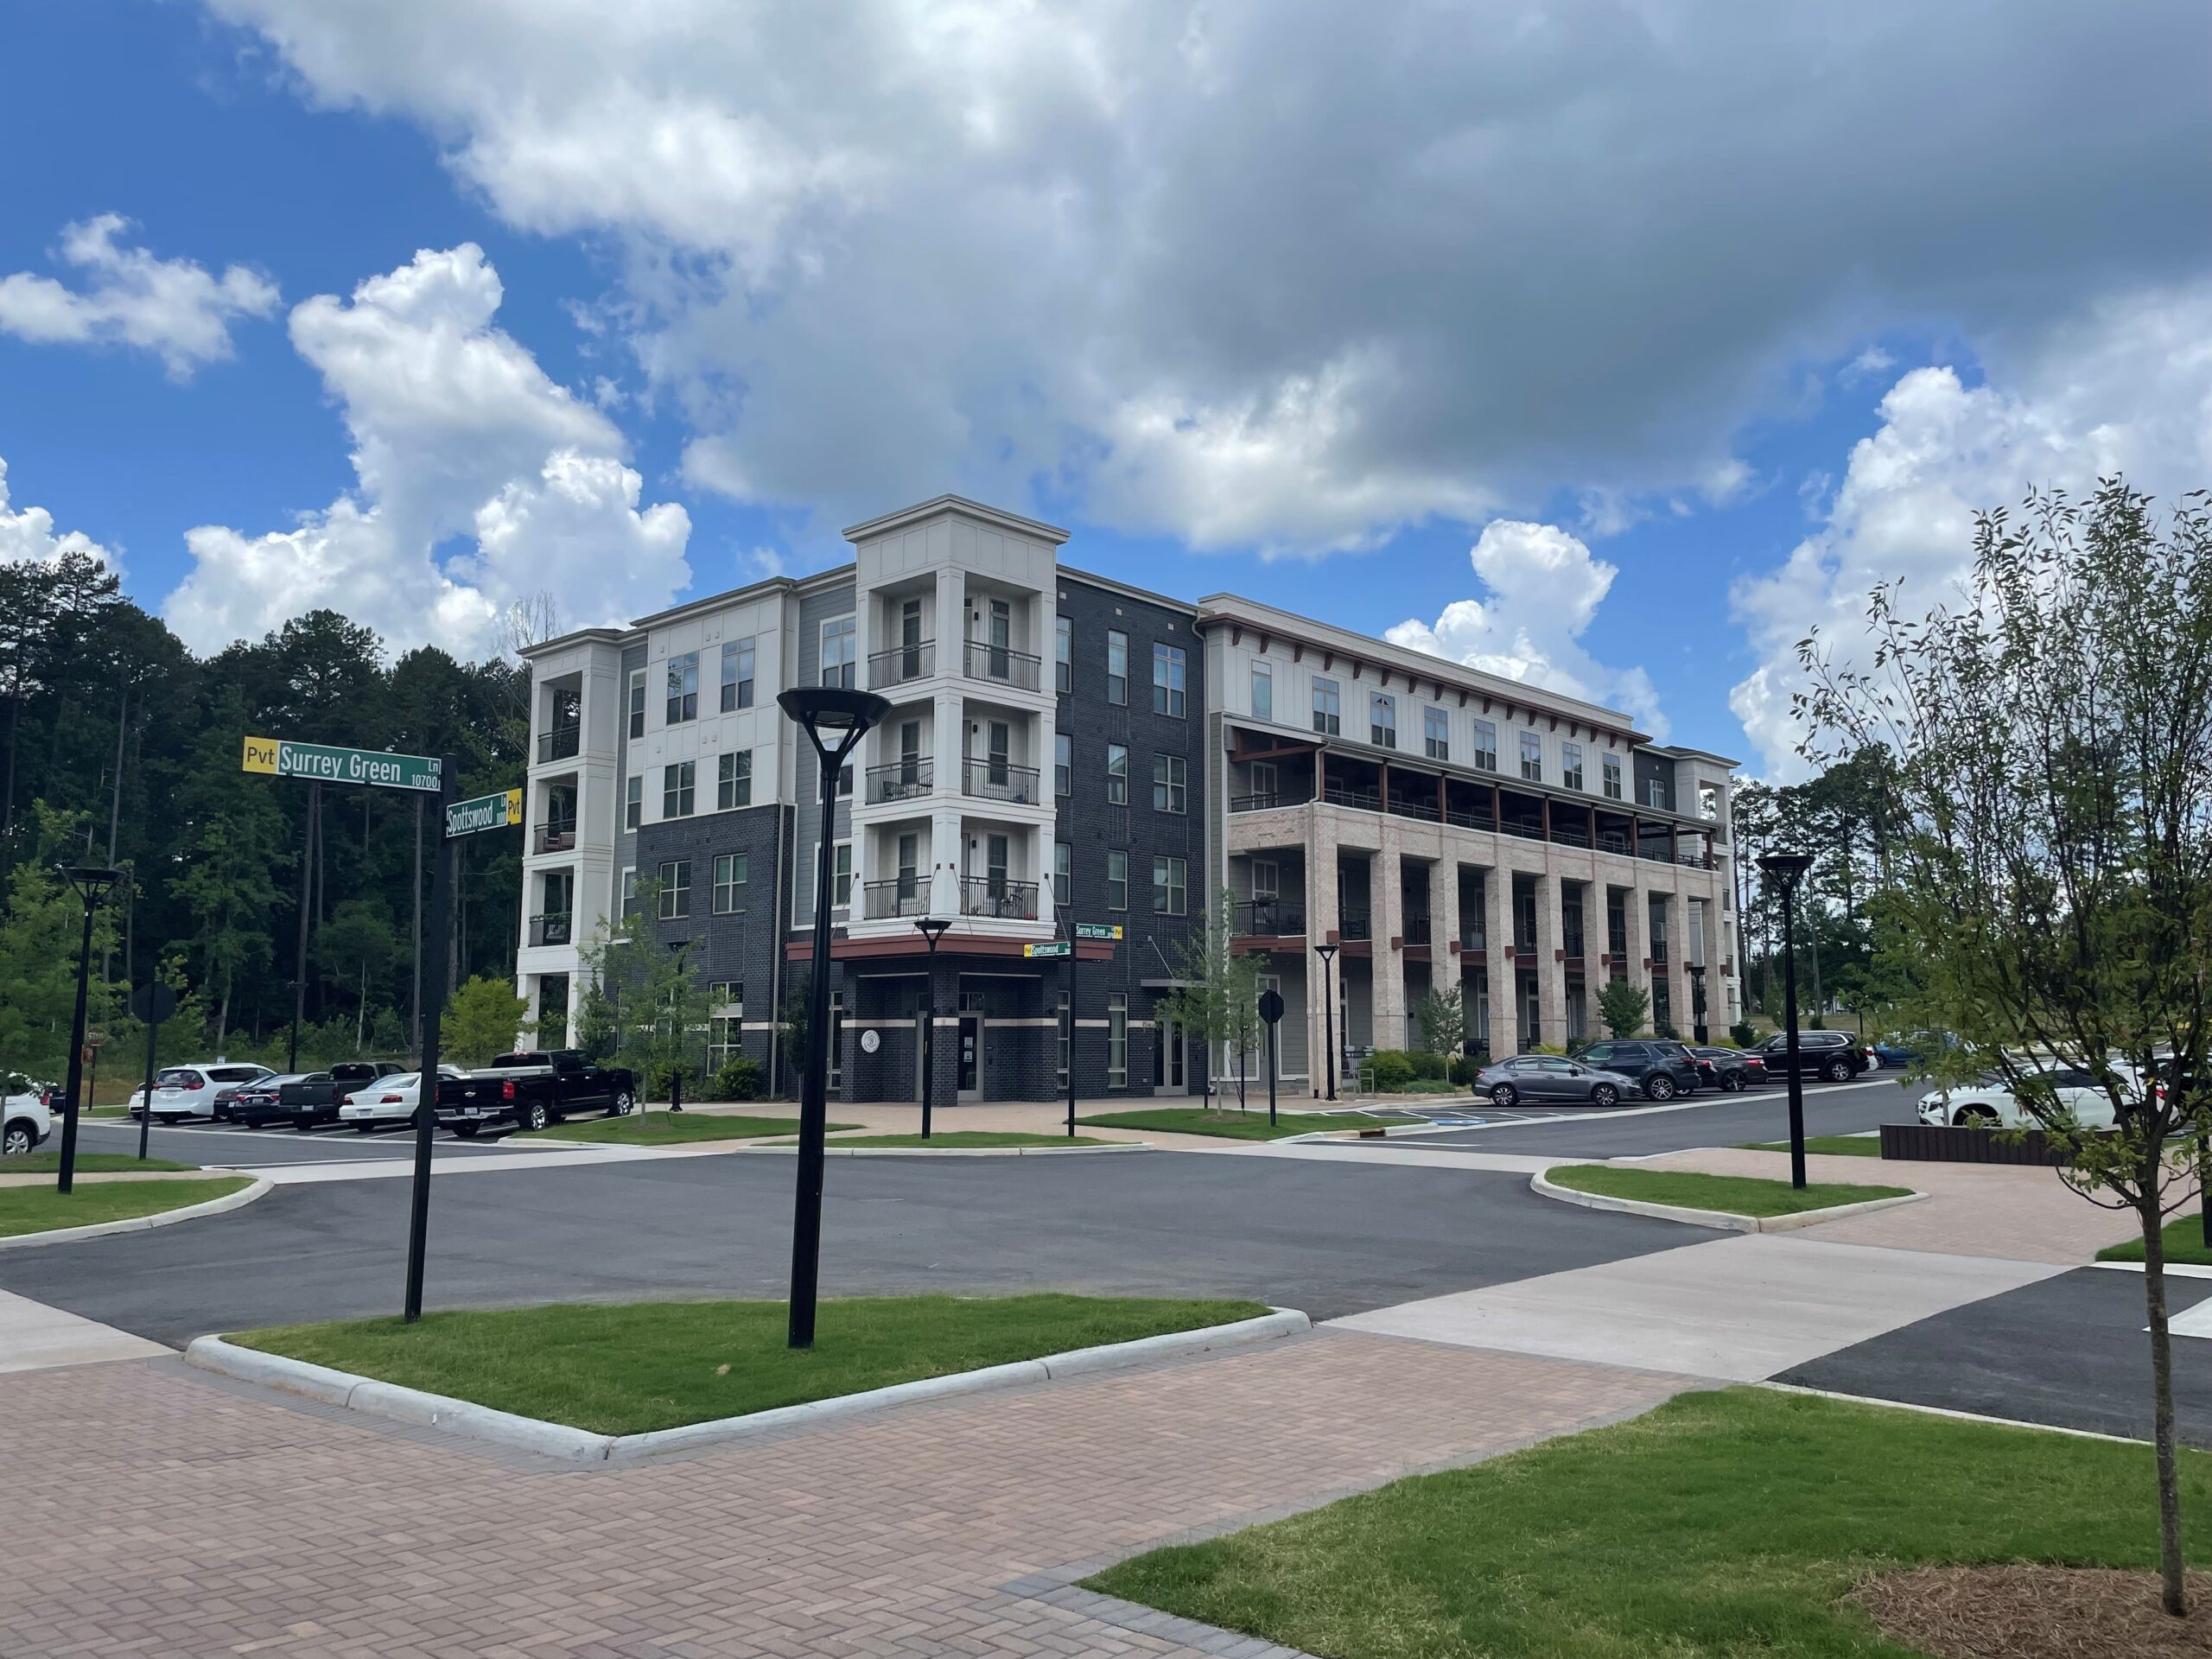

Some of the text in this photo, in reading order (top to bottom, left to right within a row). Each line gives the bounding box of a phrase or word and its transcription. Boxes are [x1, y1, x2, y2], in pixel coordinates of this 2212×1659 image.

[247, 746, 401, 782] Pvt Surrey Green
[428, 760, 439, 772] Ln
[411, 773, 438, 788] 10700
[448, 798, 520, 835] Spottswood Pvt
[1076, 925, 1091, 936] Surrey
[1092, 925, 1106, 936] Green
[1032, 944, 1059, 955] Spottswood
